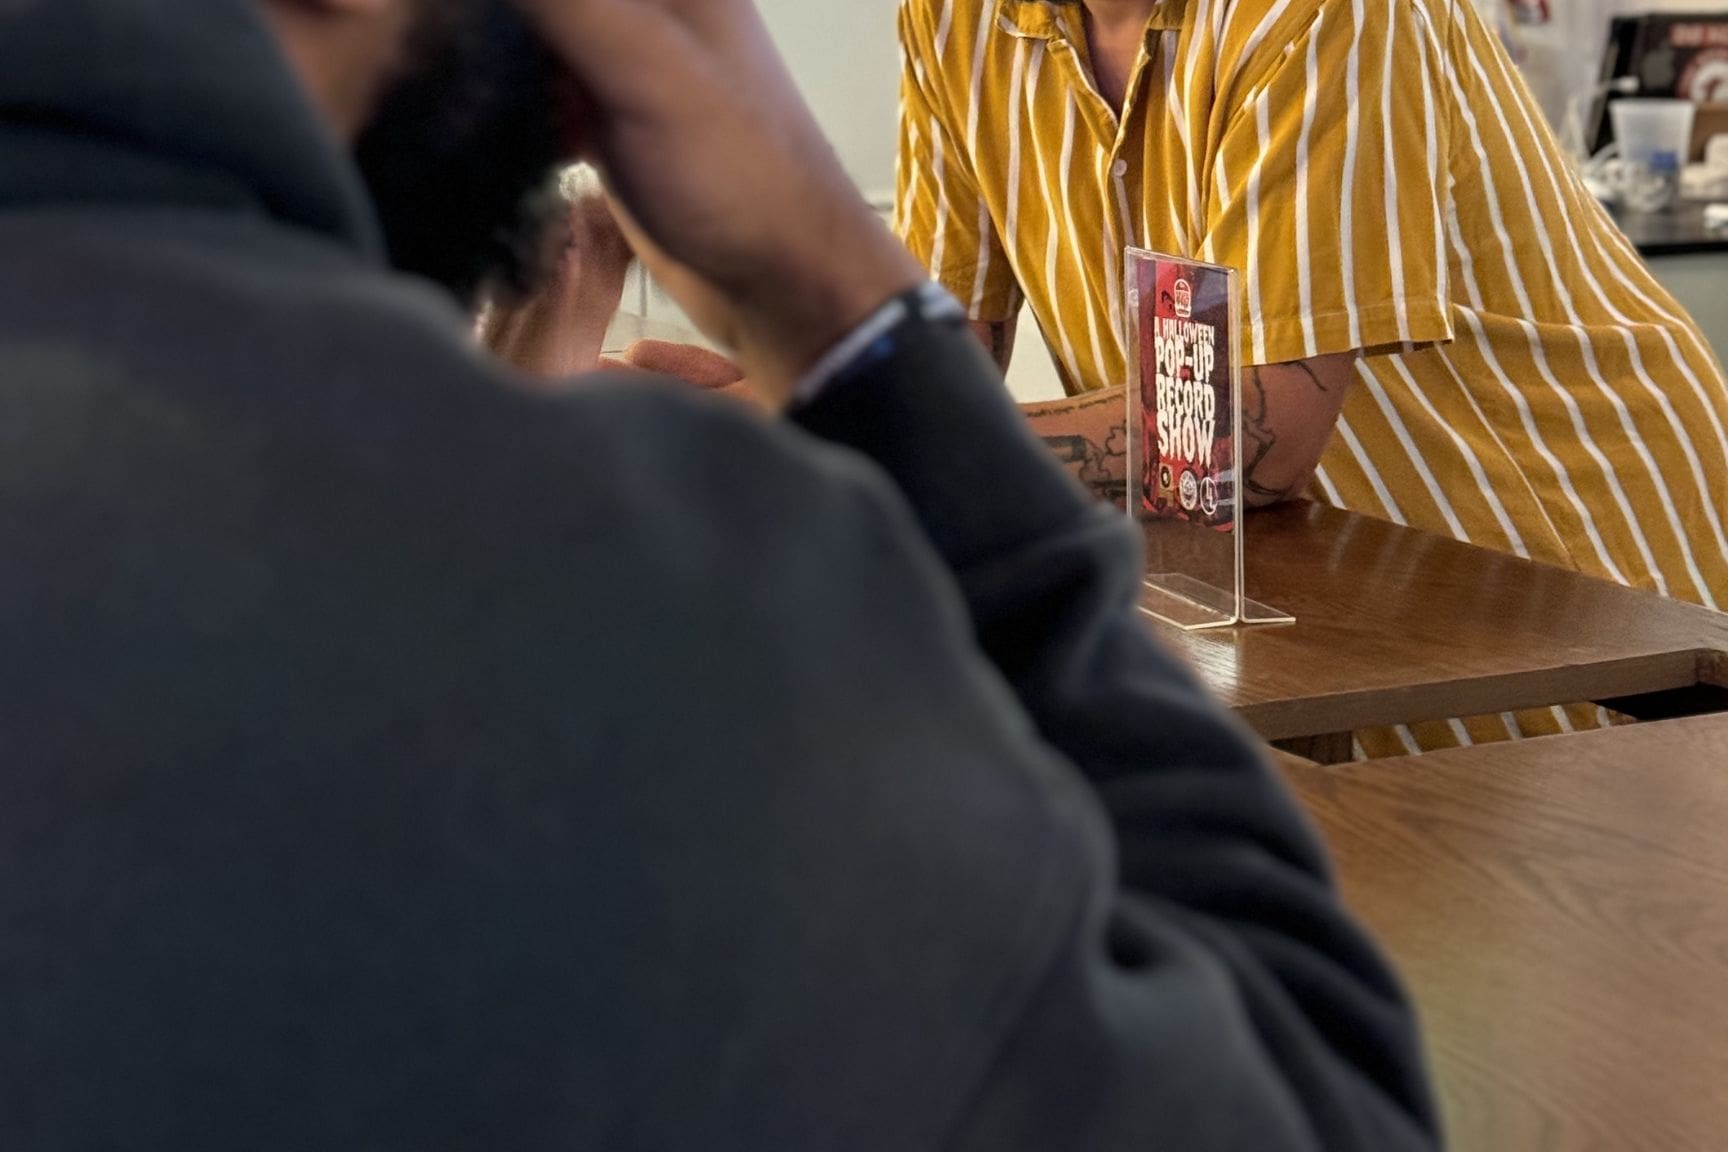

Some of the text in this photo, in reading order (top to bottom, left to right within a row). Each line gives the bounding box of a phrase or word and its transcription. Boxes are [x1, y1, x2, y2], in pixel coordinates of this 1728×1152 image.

[1153, 316, 1215, 347] A HALLOWEEN
[1154, 336, 1215, 384] POP-UP
[1155, 373, 1216, 422] RECORD
[1157, 409, 1216, 469] SHOW
